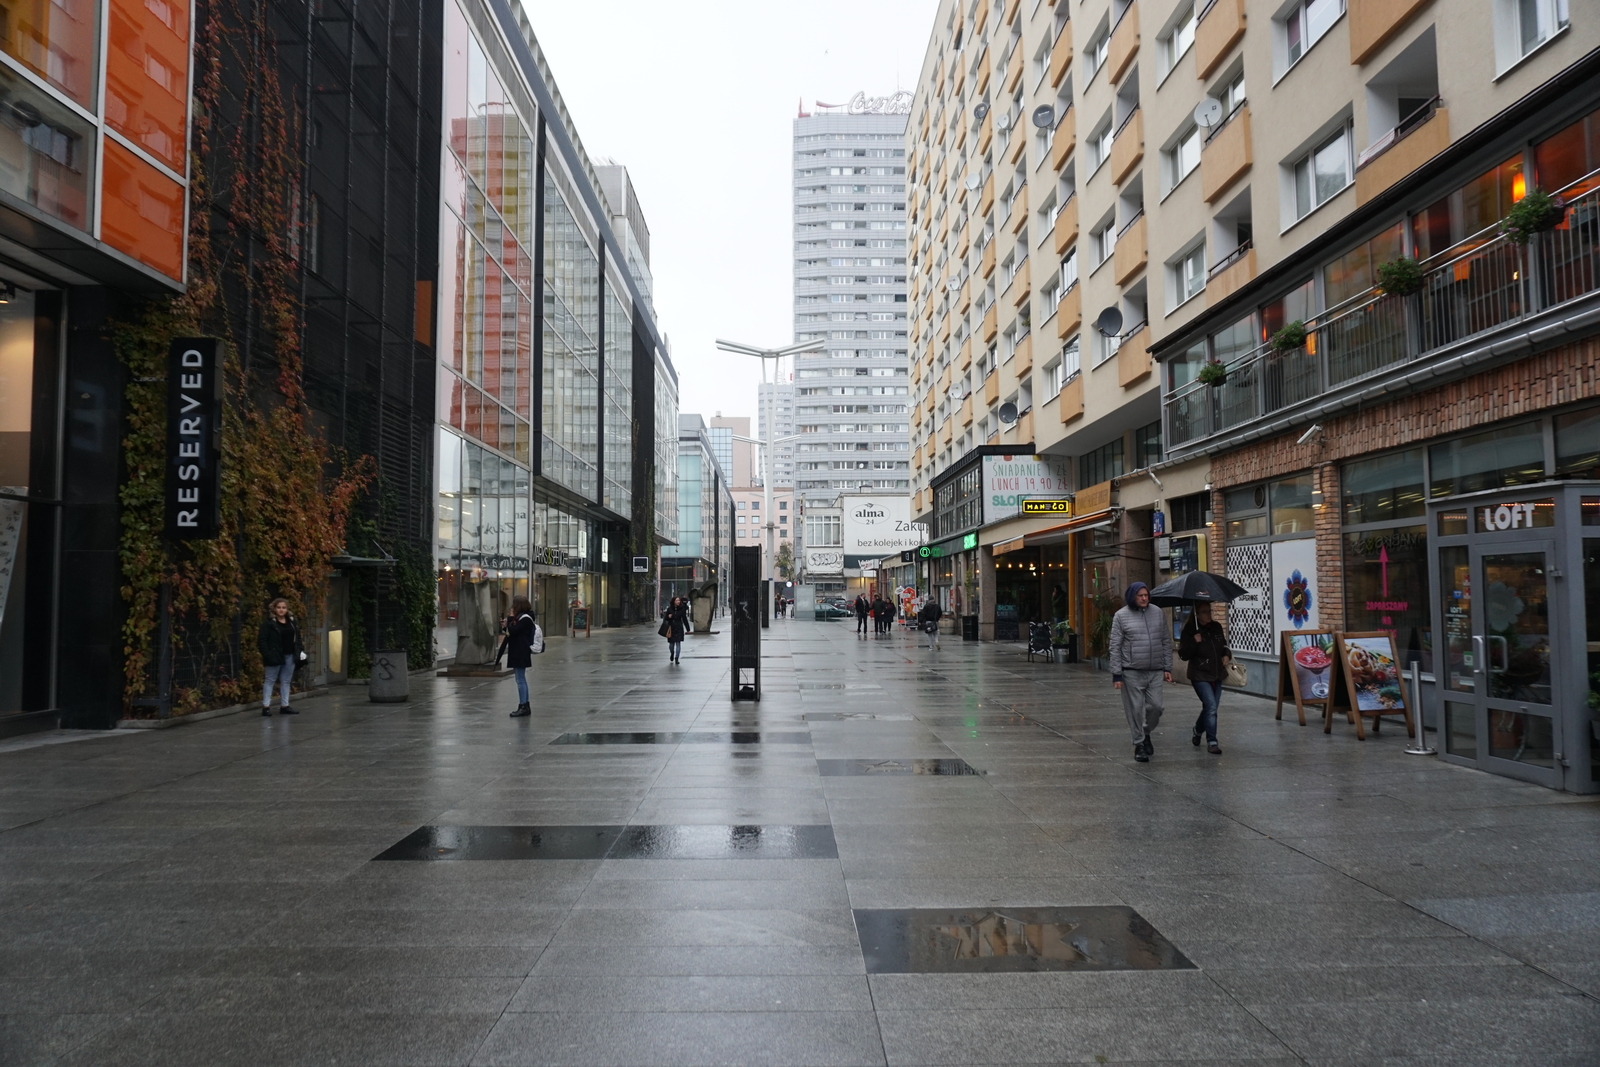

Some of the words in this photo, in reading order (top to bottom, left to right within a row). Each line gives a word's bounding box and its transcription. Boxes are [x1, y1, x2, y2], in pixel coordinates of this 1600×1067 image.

[848, 91, 914, 115] Coca-Col
[177, 349, 203, 527] RESERVED
[993, 462, 1041, 476] ŚNIADANIE
[992, 477, 1020, 491] LUNCH
[1025, 477, 1052, 491] 19,90
[855, 509, 884, 518] alma
[1485, 502, 1535, 531] LOFT
[857, 539, 872, 547] bez
[874, 539, 903, 548] kolejek
